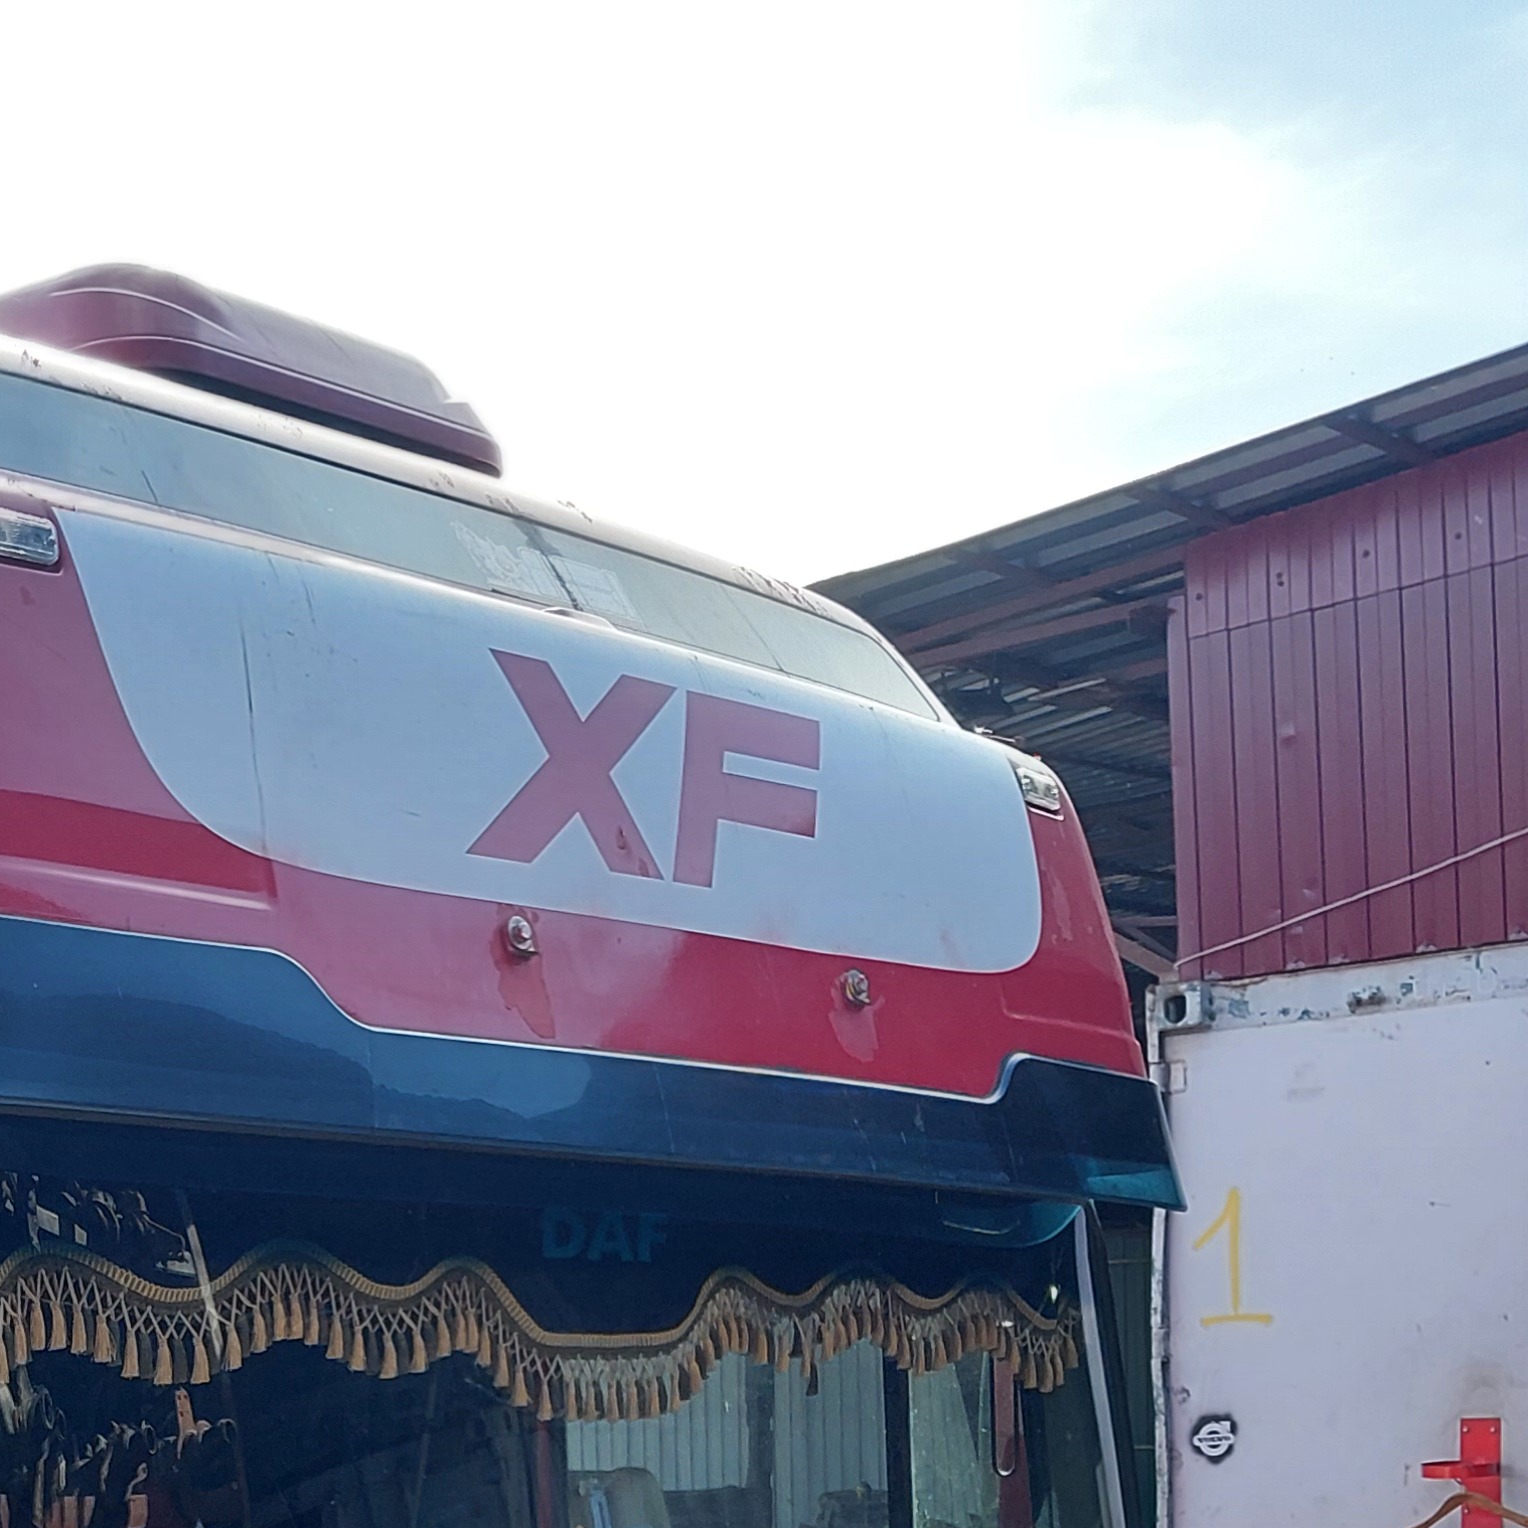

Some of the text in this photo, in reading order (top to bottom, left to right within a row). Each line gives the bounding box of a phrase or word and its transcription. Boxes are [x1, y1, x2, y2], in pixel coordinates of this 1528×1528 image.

[465, 647, 821, 888] XF
[541, 1206, 668, 1263] DAF
[1192, 1187, 1273, 1326] 1
